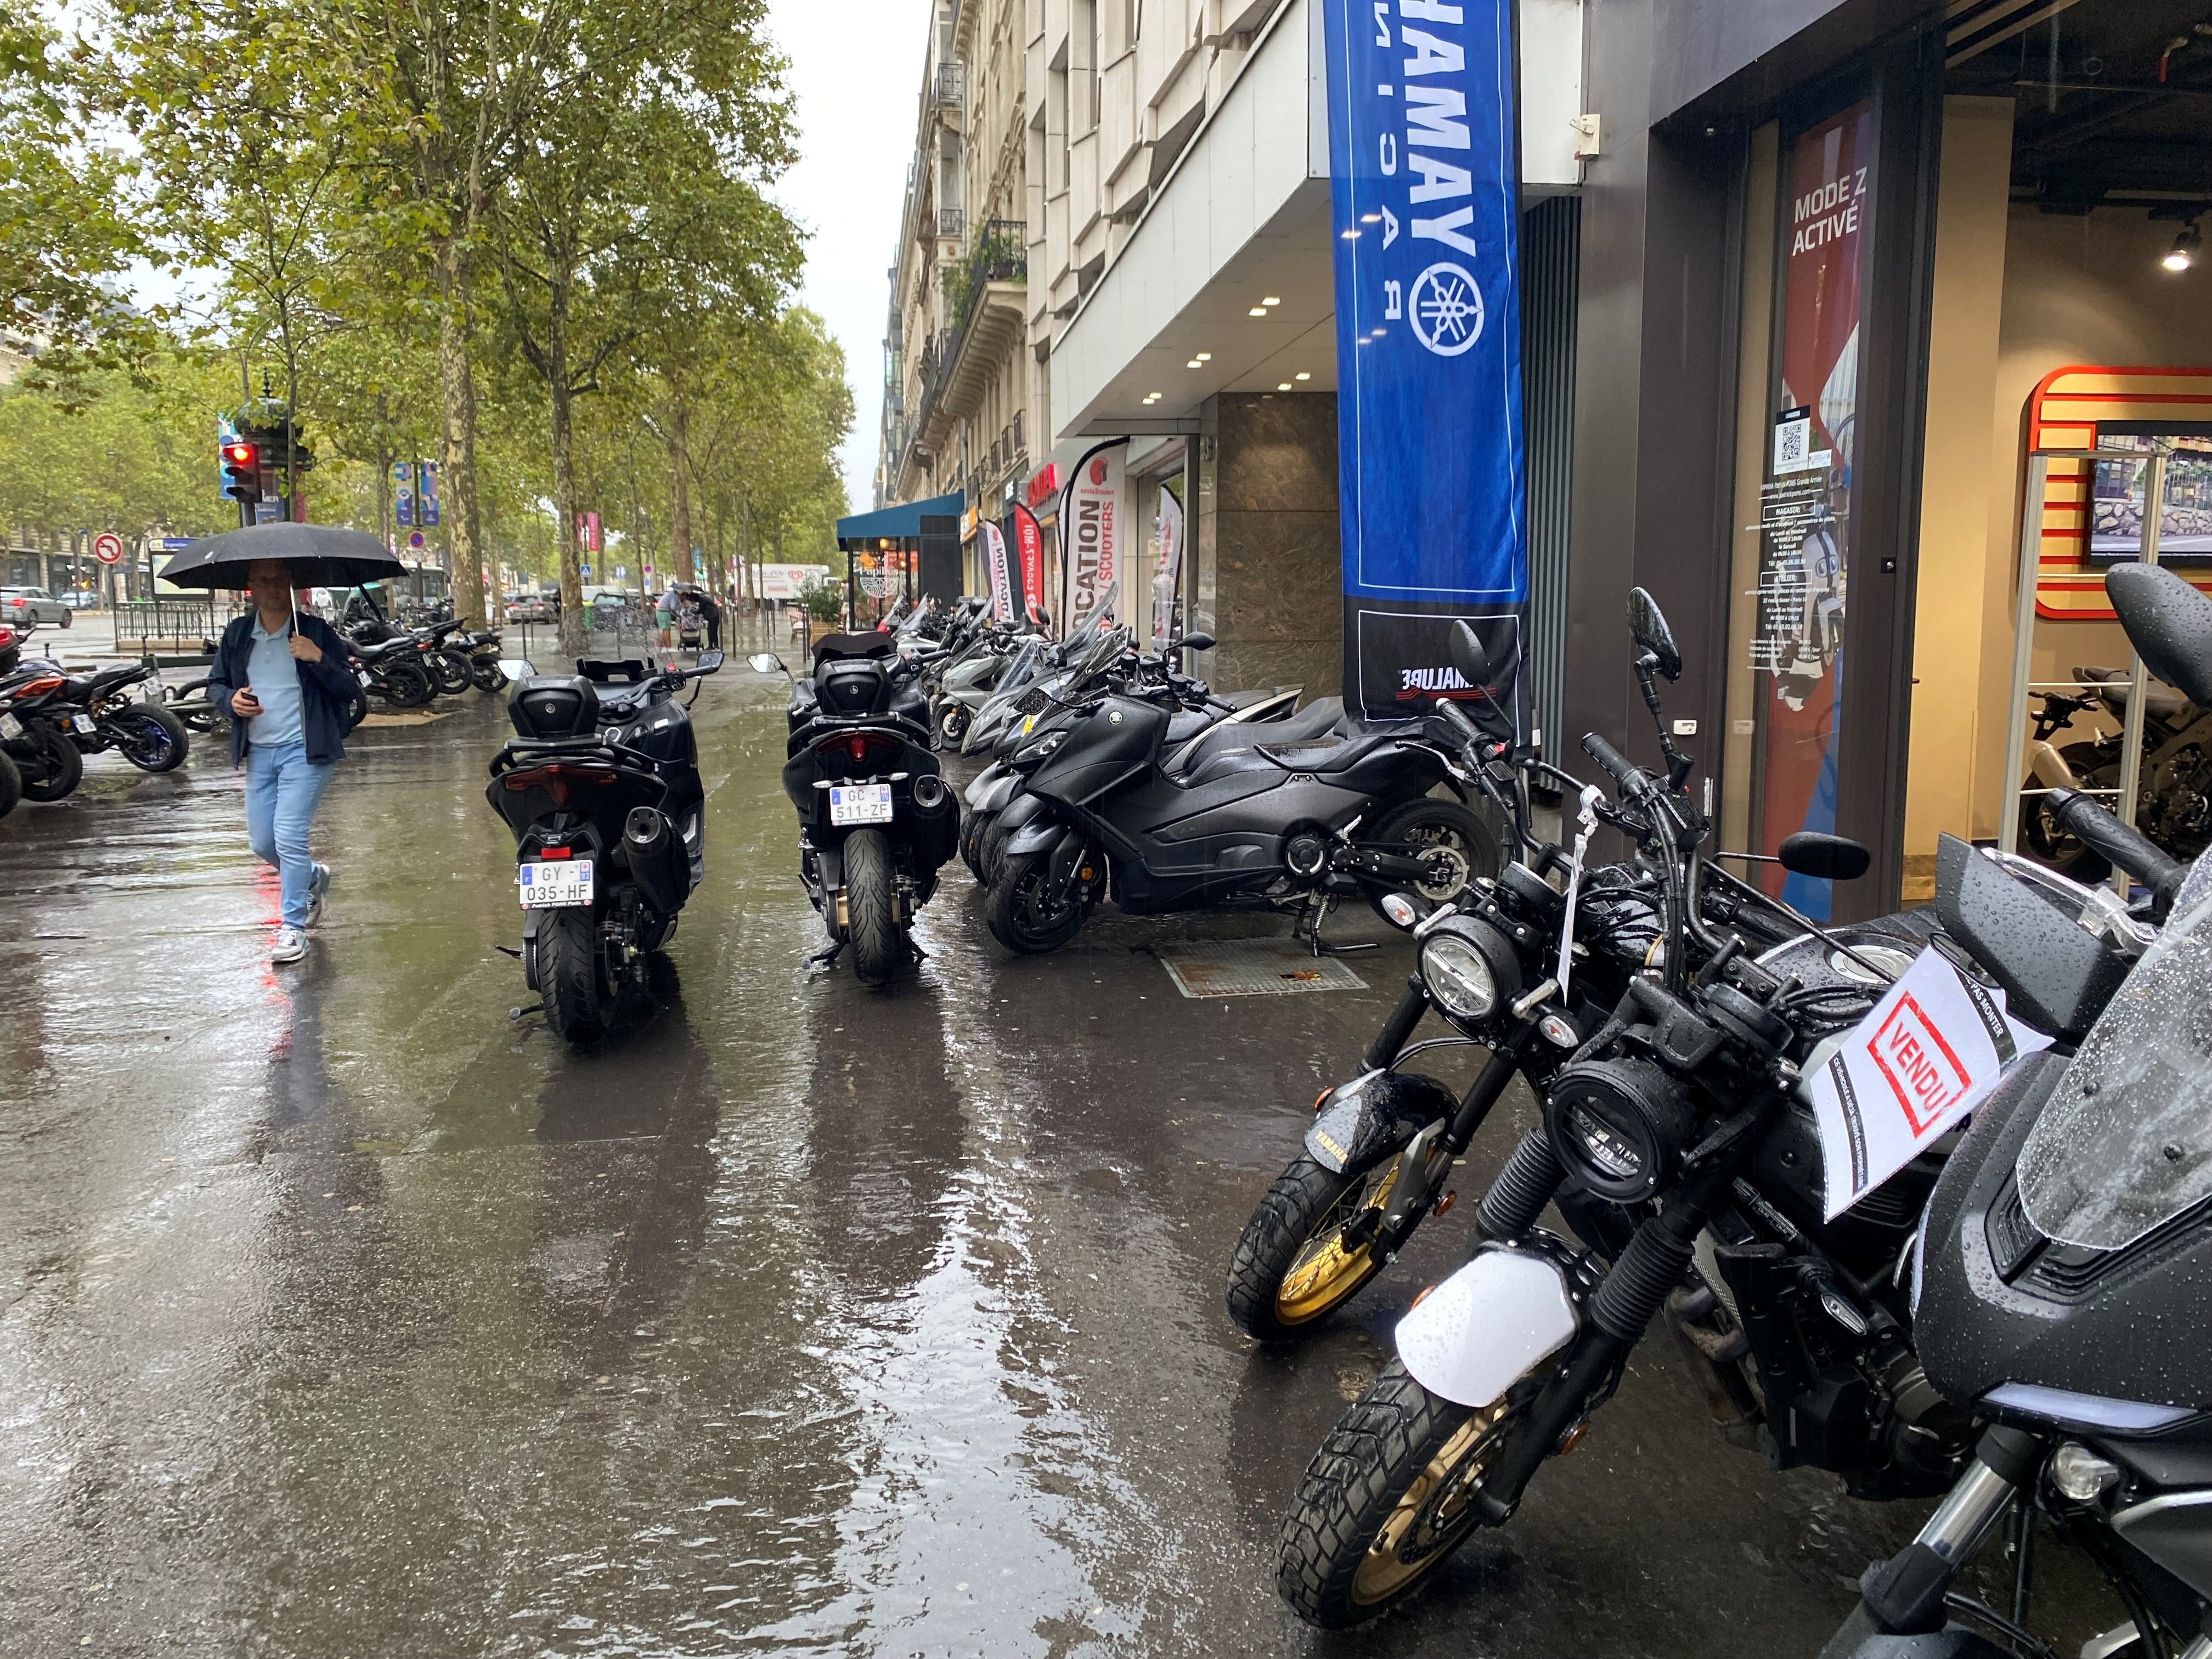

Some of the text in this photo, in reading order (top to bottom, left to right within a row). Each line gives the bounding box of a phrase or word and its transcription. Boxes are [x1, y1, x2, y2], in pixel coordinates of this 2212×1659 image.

[1795, 167, 1867, 223] MODE Z
[1792, 199, 1858, 256] ACTIVÉ
[1099, 501, 1114, 580] SCOOTERS
[1073, 500, 1099, 630] OCATION
[848, 789, 865, 802] GC
[837, 804, 887, 819] 511-ZF
[542, 866, 561, 881] GY
[580, 873, 590, 881] 92
[527, 884, 587, 901] 035-HF
[1971, 984, 2004, 1038] PAS MONTER
[1833, 1057, 1841, 1068] CE
[1888, 1022, 1949, 1111] VENDU
[1836, 1065, 1850, 1096] VÉHICULE
[1851, 1114, 1861, 1139] TROUVÉ
[1315, 1130, 1348, 1164] YAMAHA
